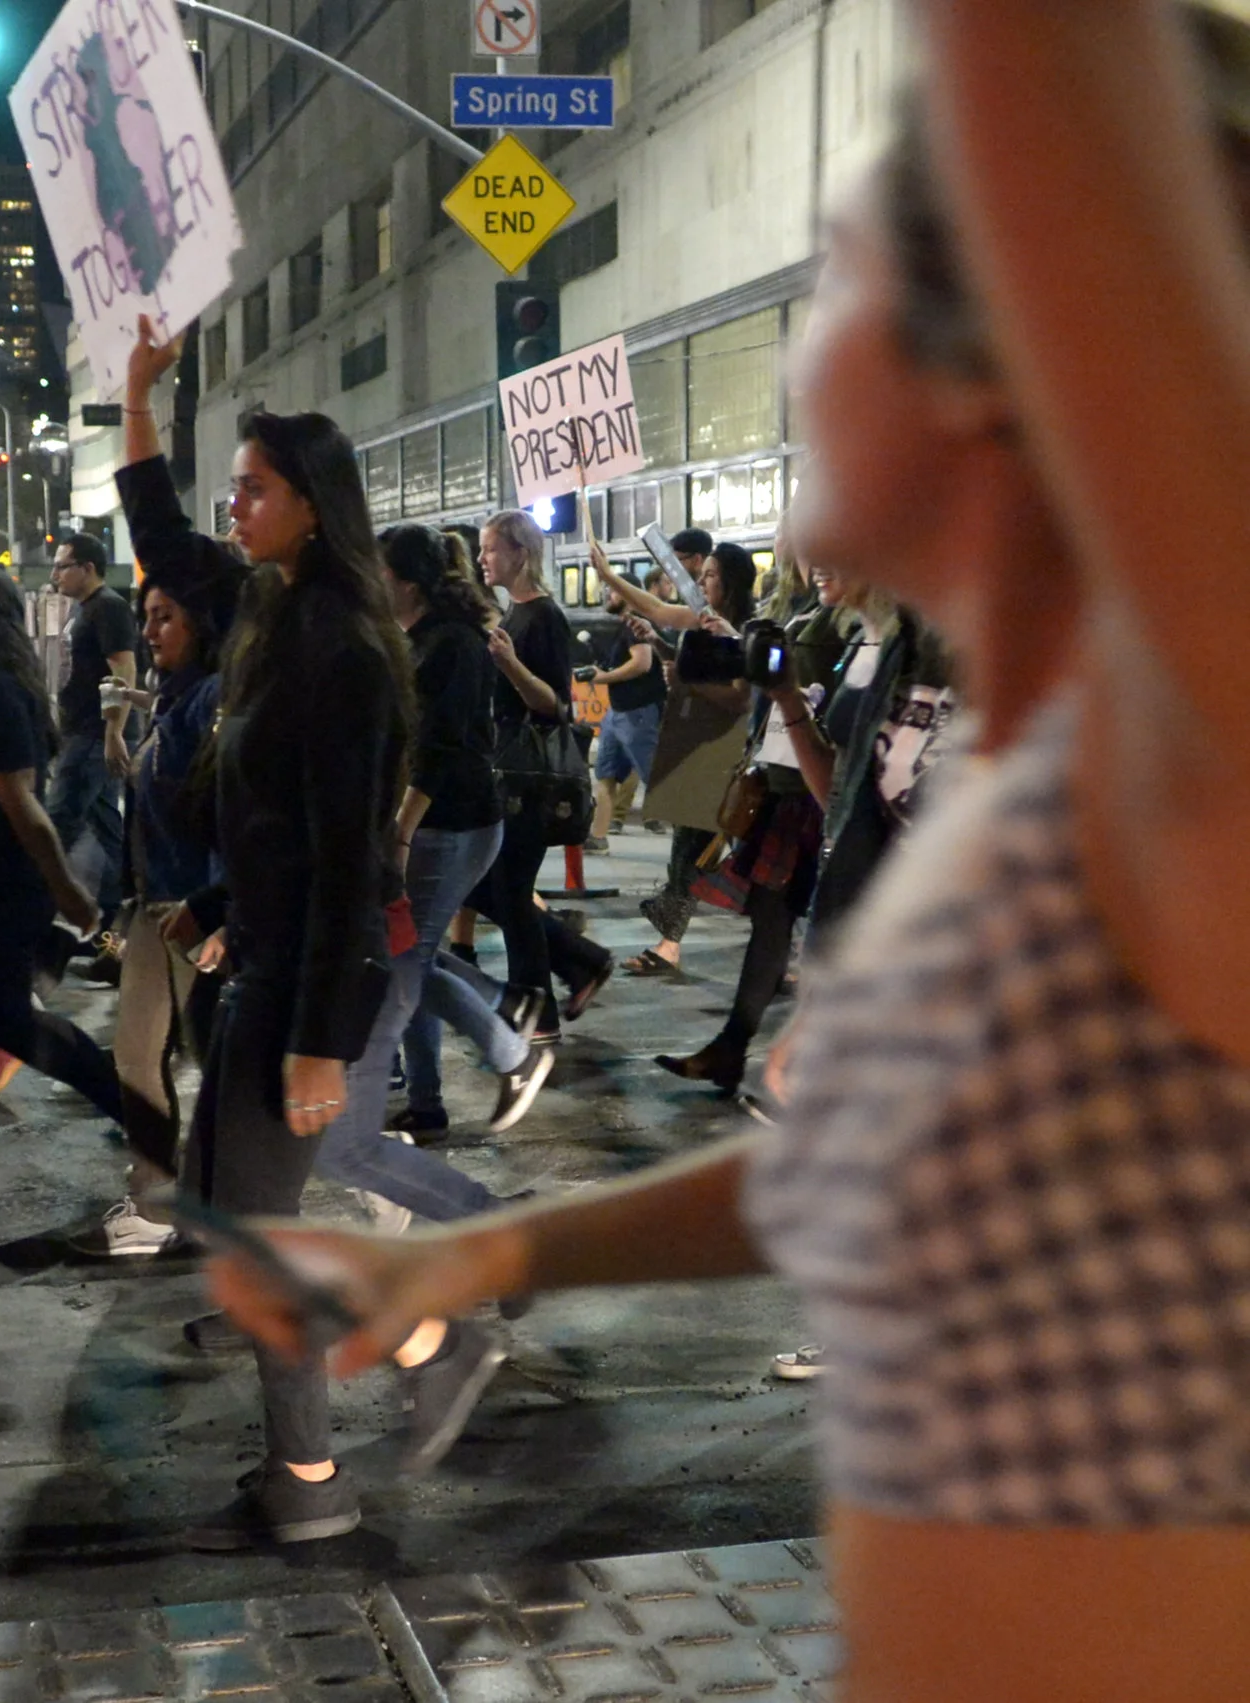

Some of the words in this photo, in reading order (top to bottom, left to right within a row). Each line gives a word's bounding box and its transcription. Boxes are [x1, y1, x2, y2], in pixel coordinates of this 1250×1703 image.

[468, 83, 557, 121] Spring
[569, 87, 599, 115] St
[473, 174, 545, 198] DEAD
[483, 211, 536, 234] END
[508, 363, 572, 427] NOT
[577, 346, 619, 404] MY
[510, 401, 637, 487] PRESIDENT
